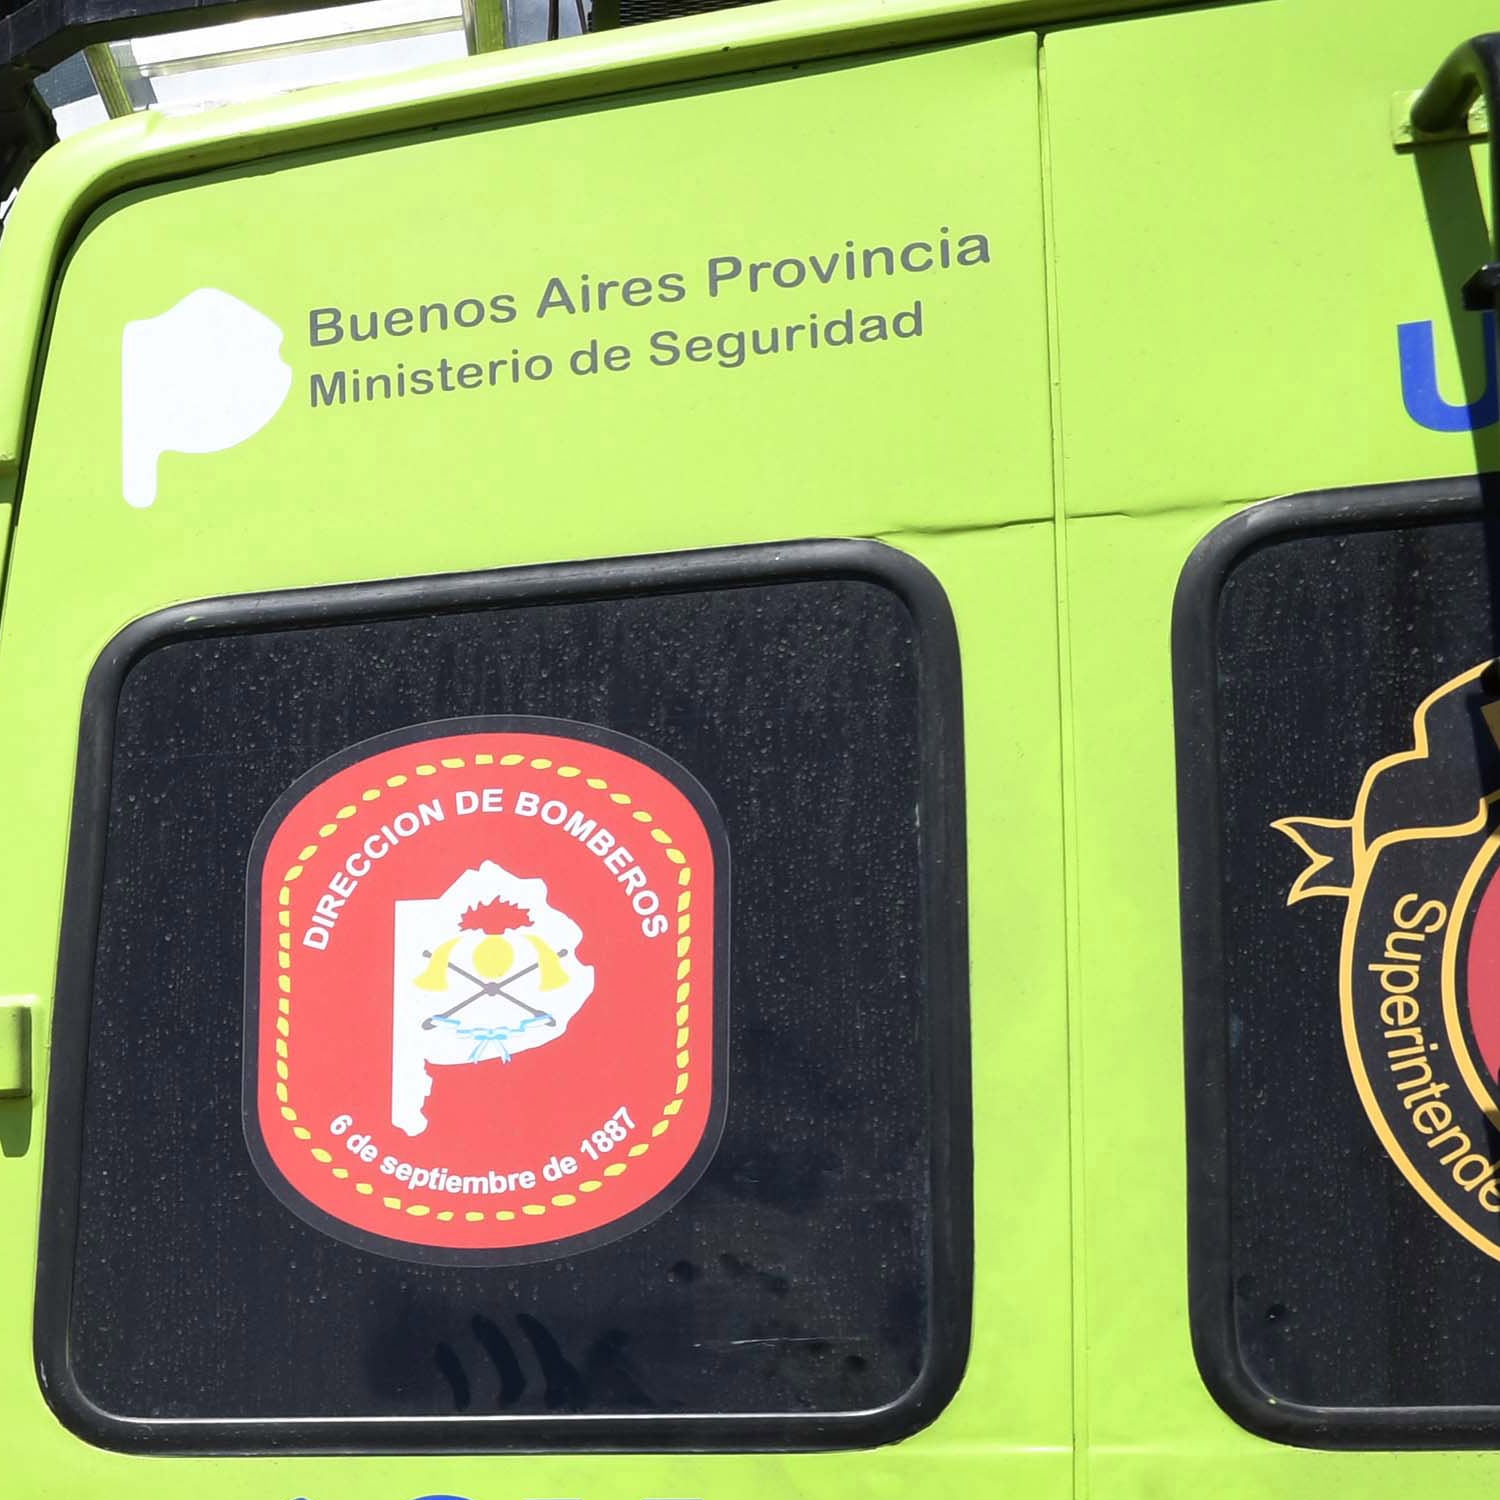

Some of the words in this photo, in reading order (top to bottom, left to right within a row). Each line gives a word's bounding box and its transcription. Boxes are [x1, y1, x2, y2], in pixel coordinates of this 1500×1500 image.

[308, 292, 518, 347] Buenos
[536, 271, 686, 319] Aires
[708, 226, 991, 297] Provincia
[308, 348, 553, 408] Ministerio
[569, 339, 632, 376] de
[648, 301, 924, 370] Seguridad
[303, 798, 444, 951] DIRECCION
[455, 788, 504, 815] DE
[514, 791, 668, 939] BOMBEROS
[329, 1114, 353, 1136] 6
[346, 1132, 379, 1162] de
[379, 1157, 537, 1195] septiembre
[542, 1154, 579, 1182] de
[579, 1105, 637, 1162] 1887
